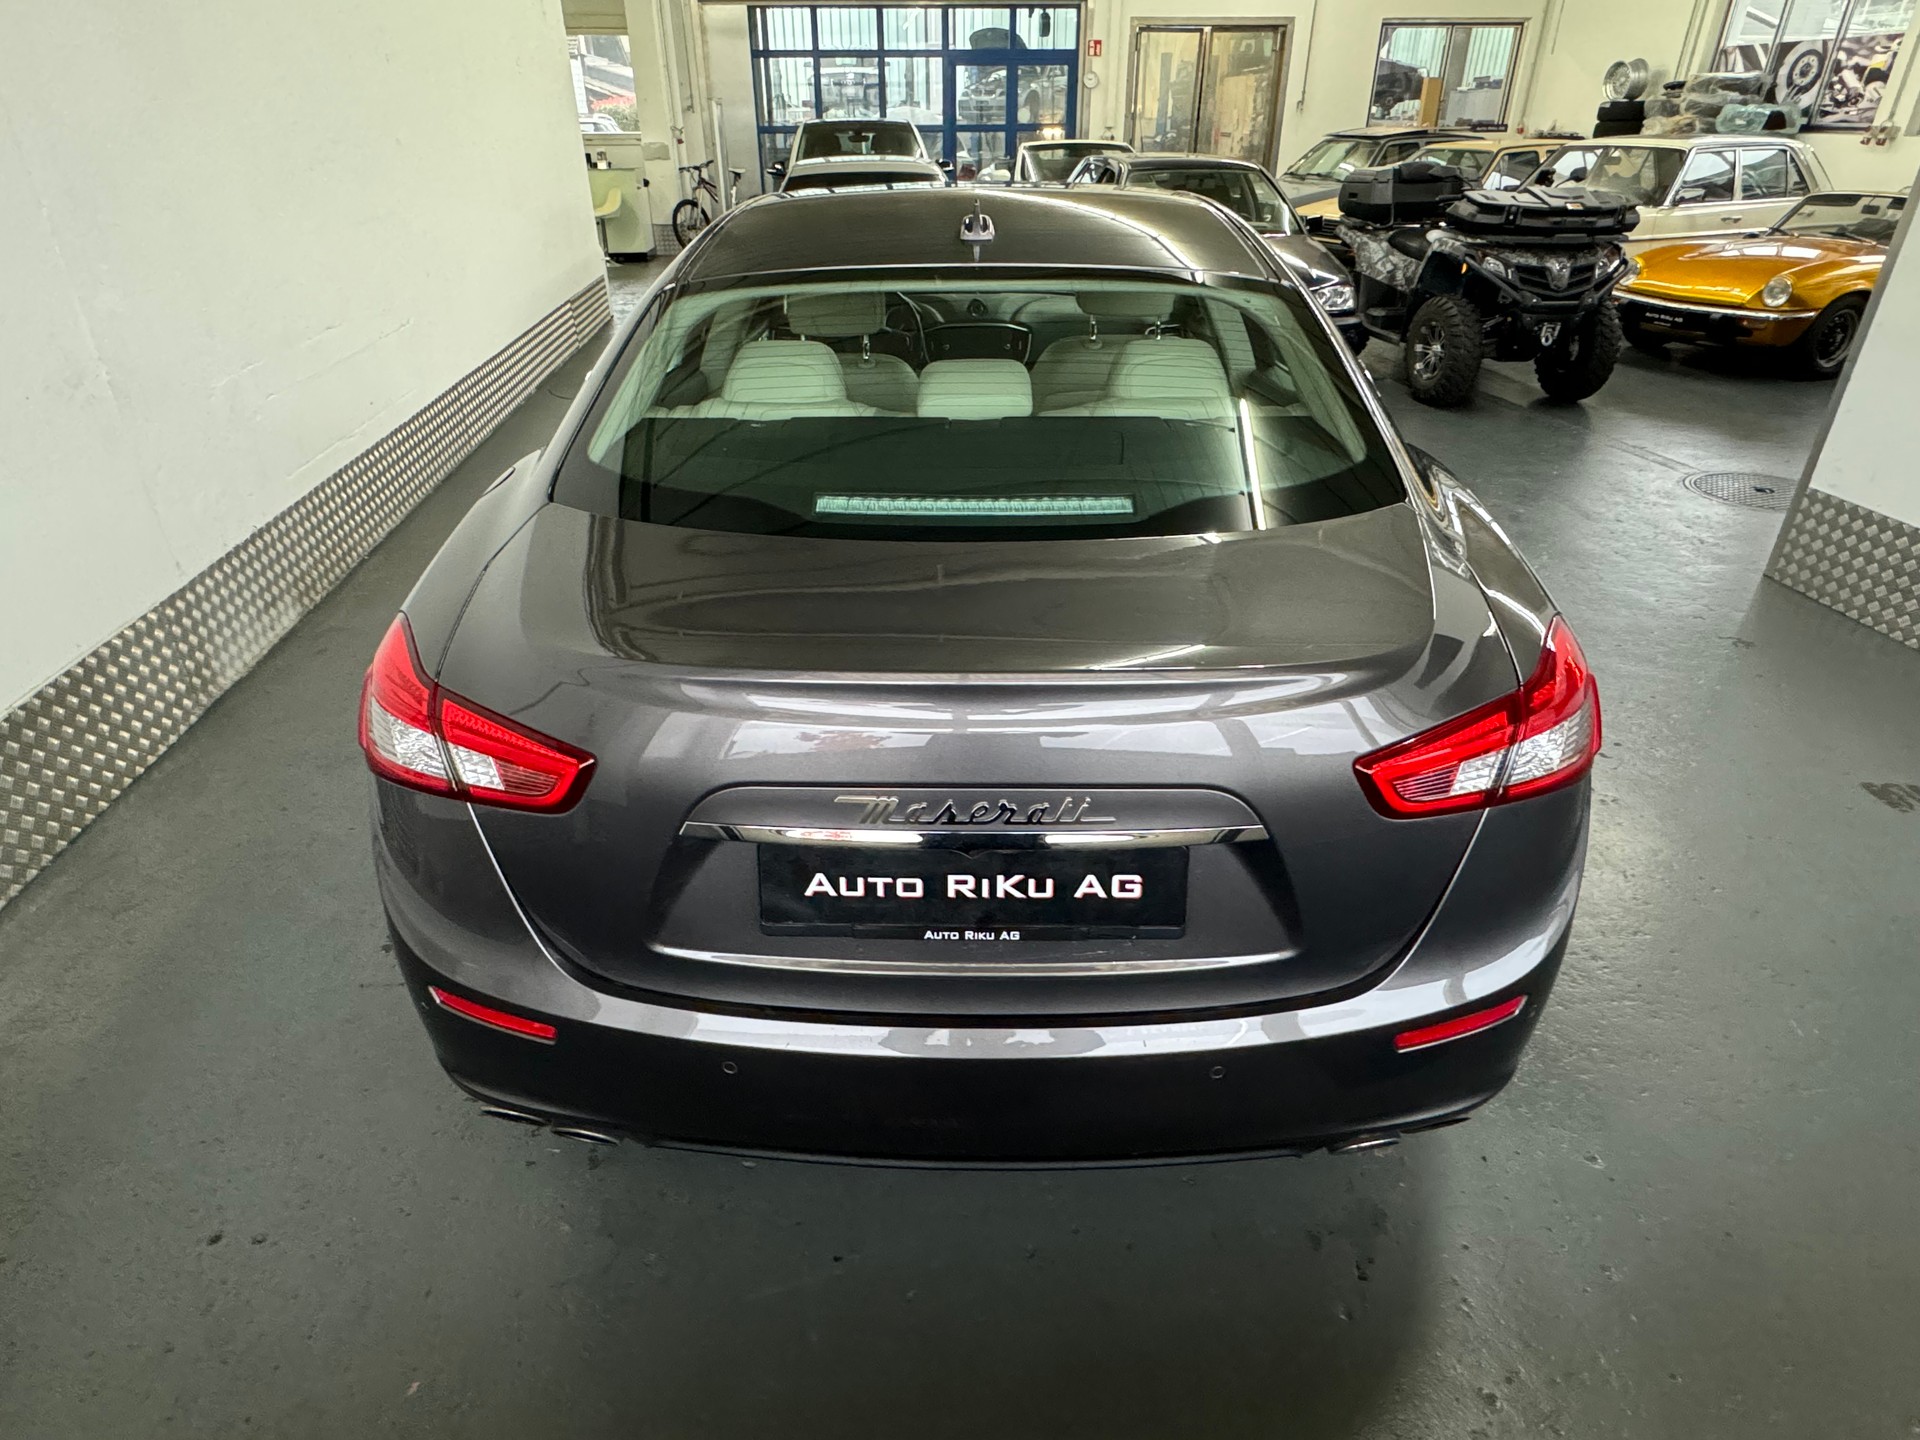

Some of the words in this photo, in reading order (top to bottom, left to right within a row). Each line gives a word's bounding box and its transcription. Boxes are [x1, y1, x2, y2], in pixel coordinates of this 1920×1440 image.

[834, 796, 1116, 825] Maserati
[1073, 874, 1143, 899] AG
[999, 930, 1020, 941] AG
